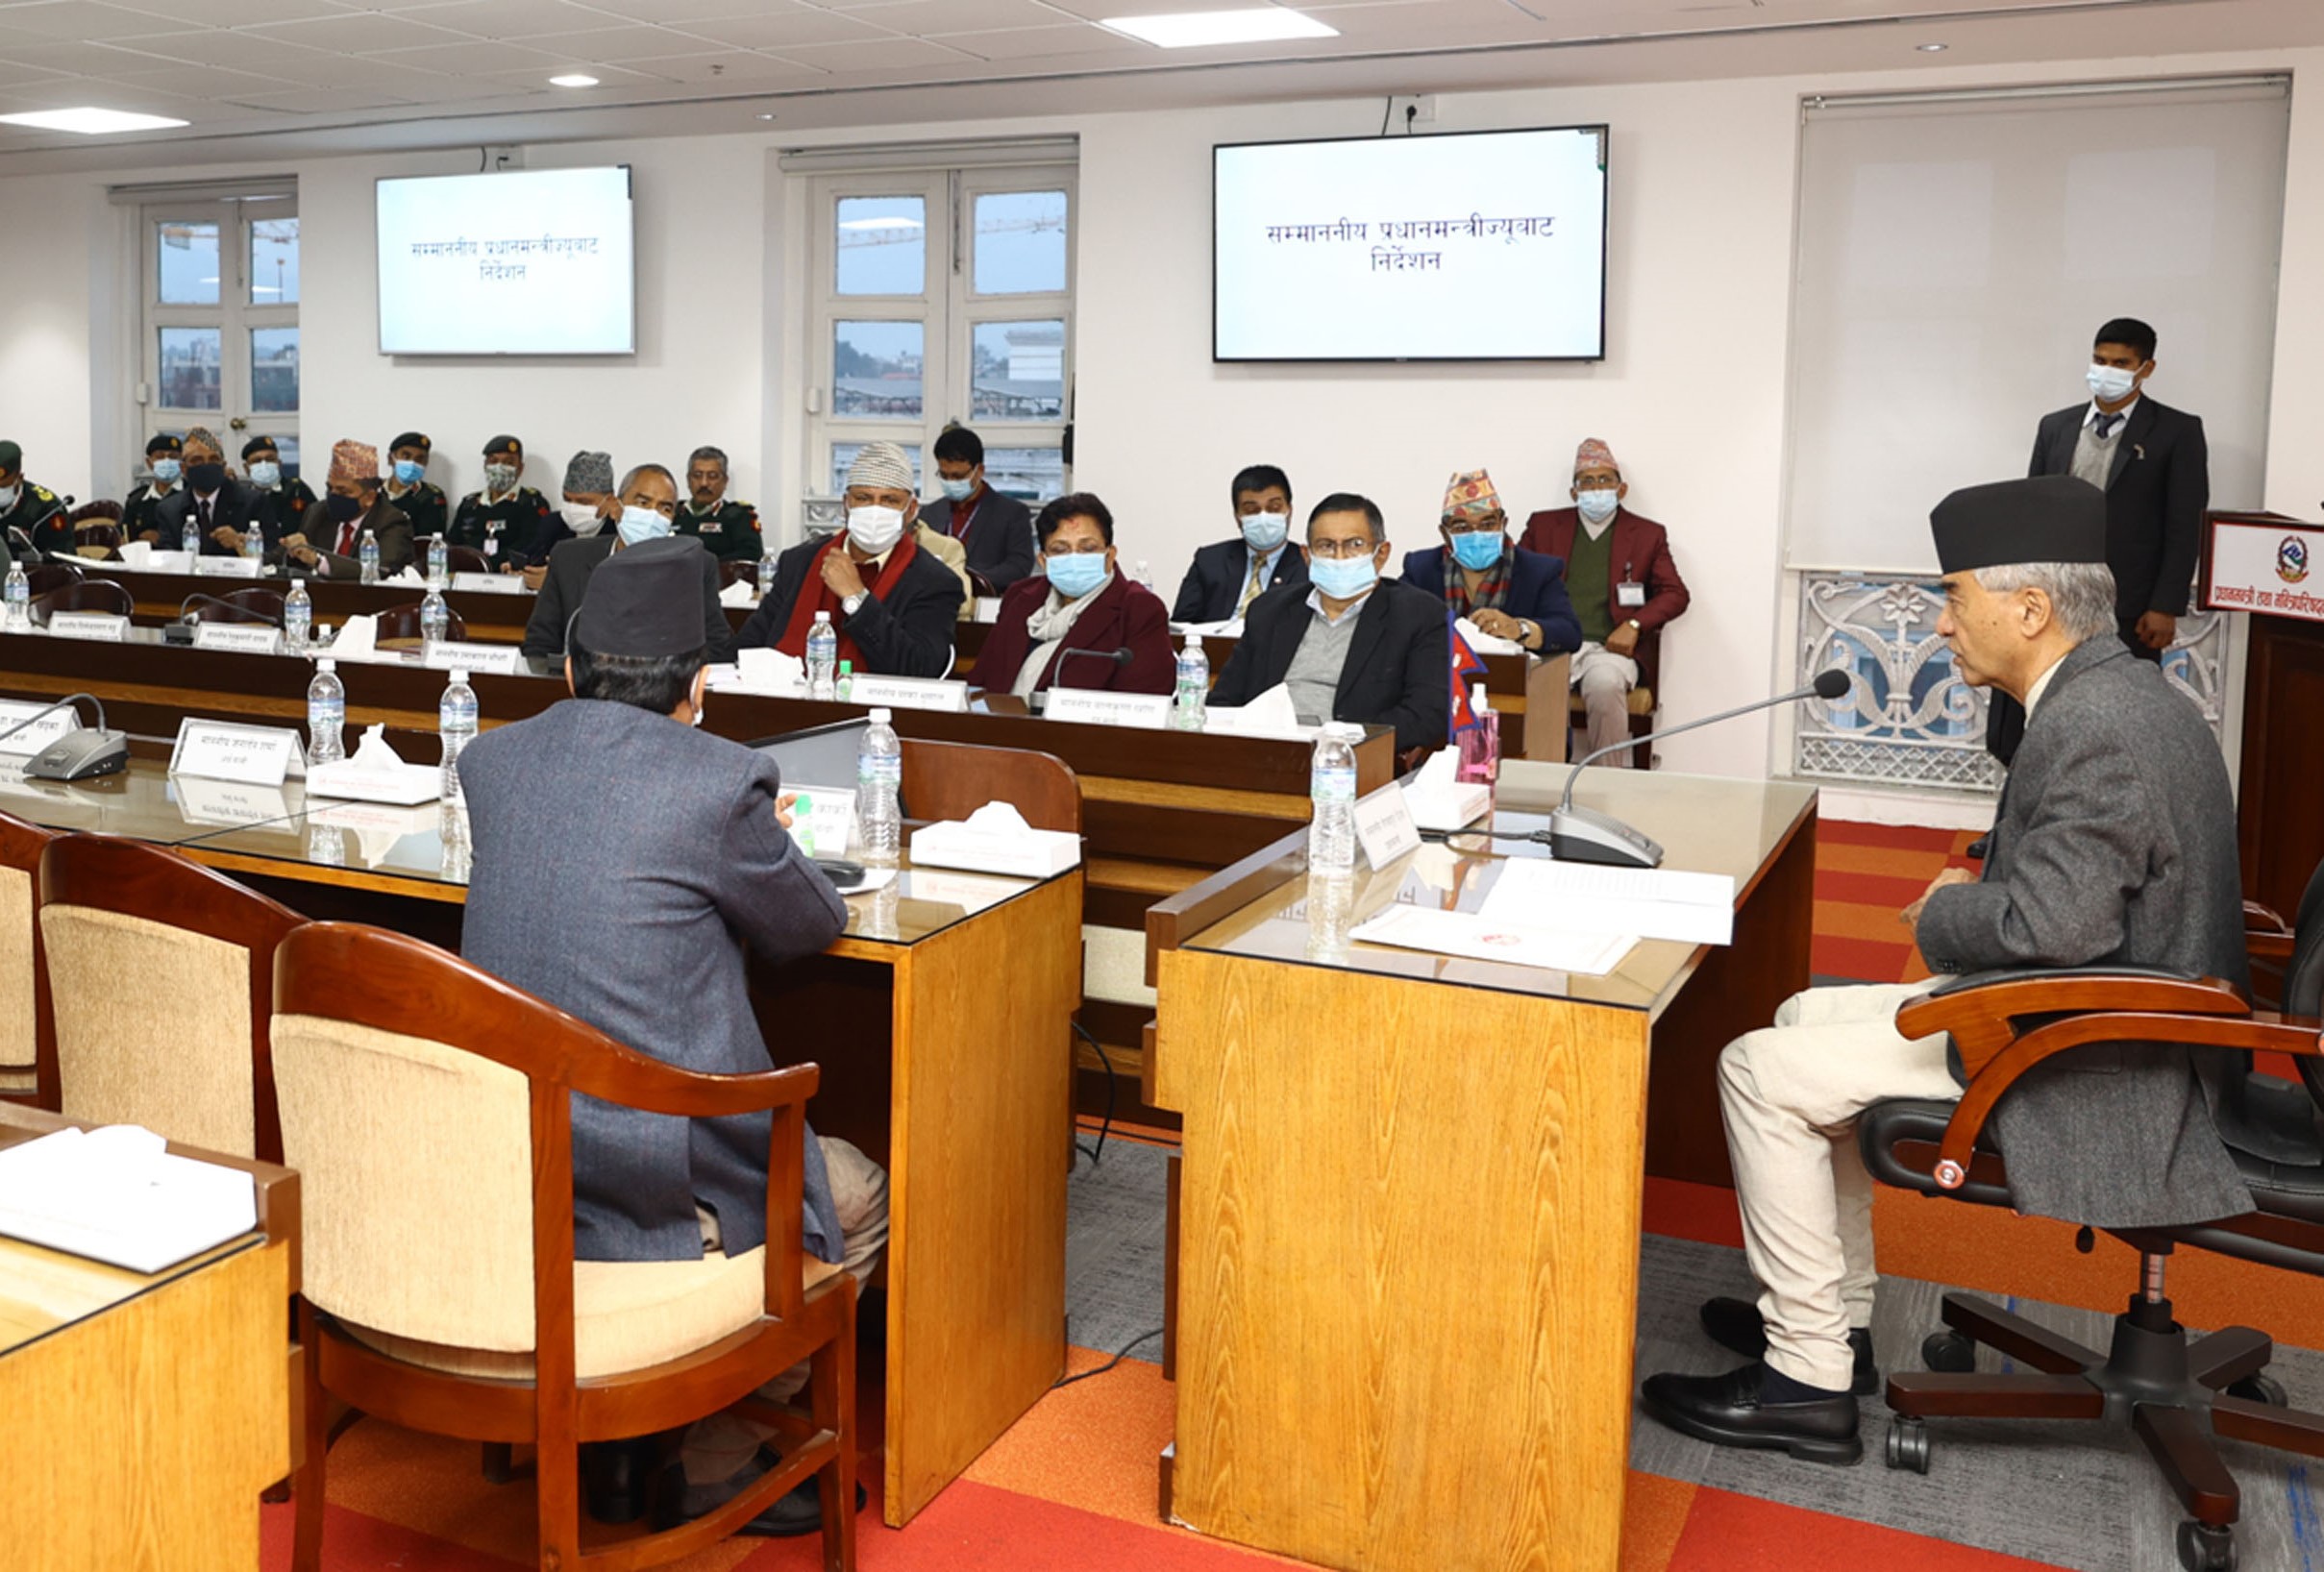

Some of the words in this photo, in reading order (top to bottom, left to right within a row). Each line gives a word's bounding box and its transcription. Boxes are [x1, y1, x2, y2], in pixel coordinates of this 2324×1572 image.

[1266, 216, 1368, 244] सम्माननीय
[480, 259, 527, 282] निर्देशन
[1371, 245, 1442, 272] निर्देशन
